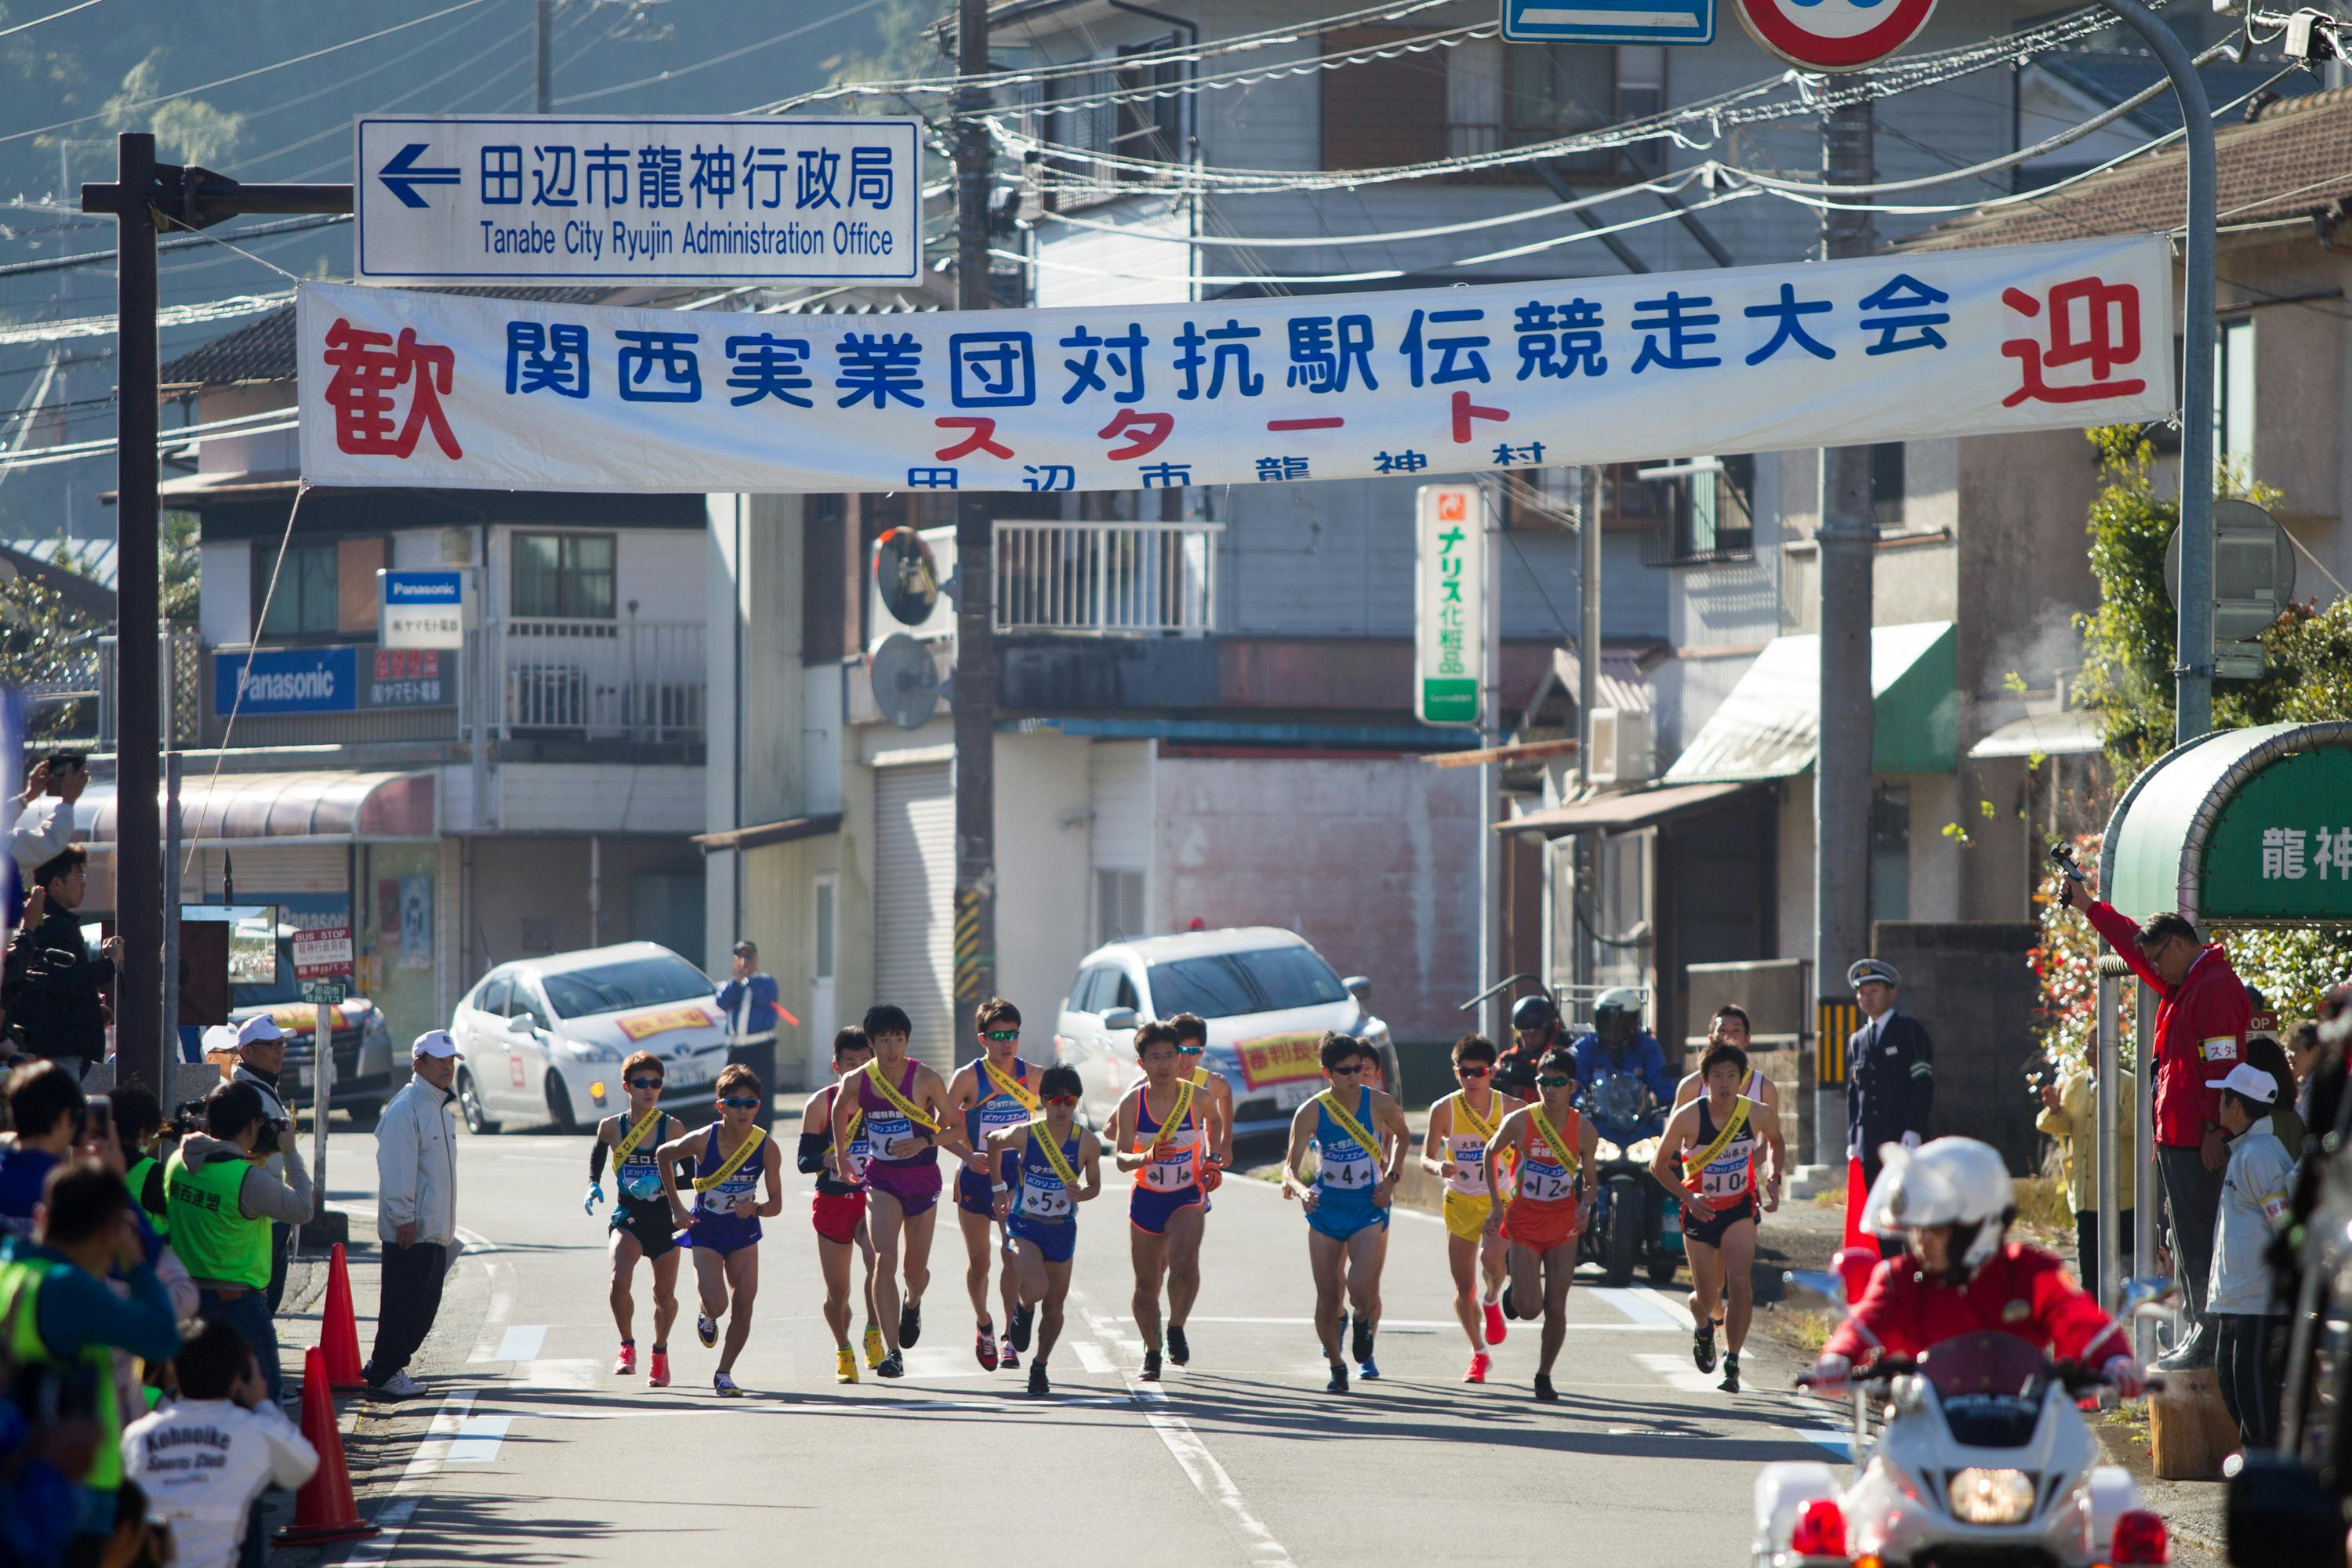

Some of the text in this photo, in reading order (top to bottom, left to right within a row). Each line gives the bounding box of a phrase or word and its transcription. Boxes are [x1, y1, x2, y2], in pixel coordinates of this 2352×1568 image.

[481, 143, 894, 210] 田辺市龍神行政局
[481, 221, 893, 261] Tanabe City Ryujin Administration Office
[506, 274, 1951, 409] 関西実業団対抗駅伝競走大会
[2001, 276, 2147, 408] 迎
[324, 318, 463, 460] 歓
[935, 390, 1510, 461] スタート
[394, 583, 456, 595] Panasonic
[1438, 526, 1465, 675] ナリス化粧品
[237, 662, 335, 701] Panasonic
[2262, 826, 2352, 880] 龍神
[278, 906, 348, 930] Panason
[296, 930, 346, 942] BUS STOP
[2250, 1018, 2270, 1029] OP
[1249, 1040, 1320, 1071] 審判長
[869, 1123, 909, 1134] ポカリスエット
[1461, 1141, 1486, 1149] 大阪府
[857, 1156, 867, 1178] 3
[1342, 1164, 1354, 1185] 4
[1475, 1163, 1484, 1181] 7
[1535, 1175, 1561, 1198] 12
[1716, 1173, 1740, 1192] 10
[724, 1194, 736, 1210] 2
[1041, 1192, 1053, 1212] 5
